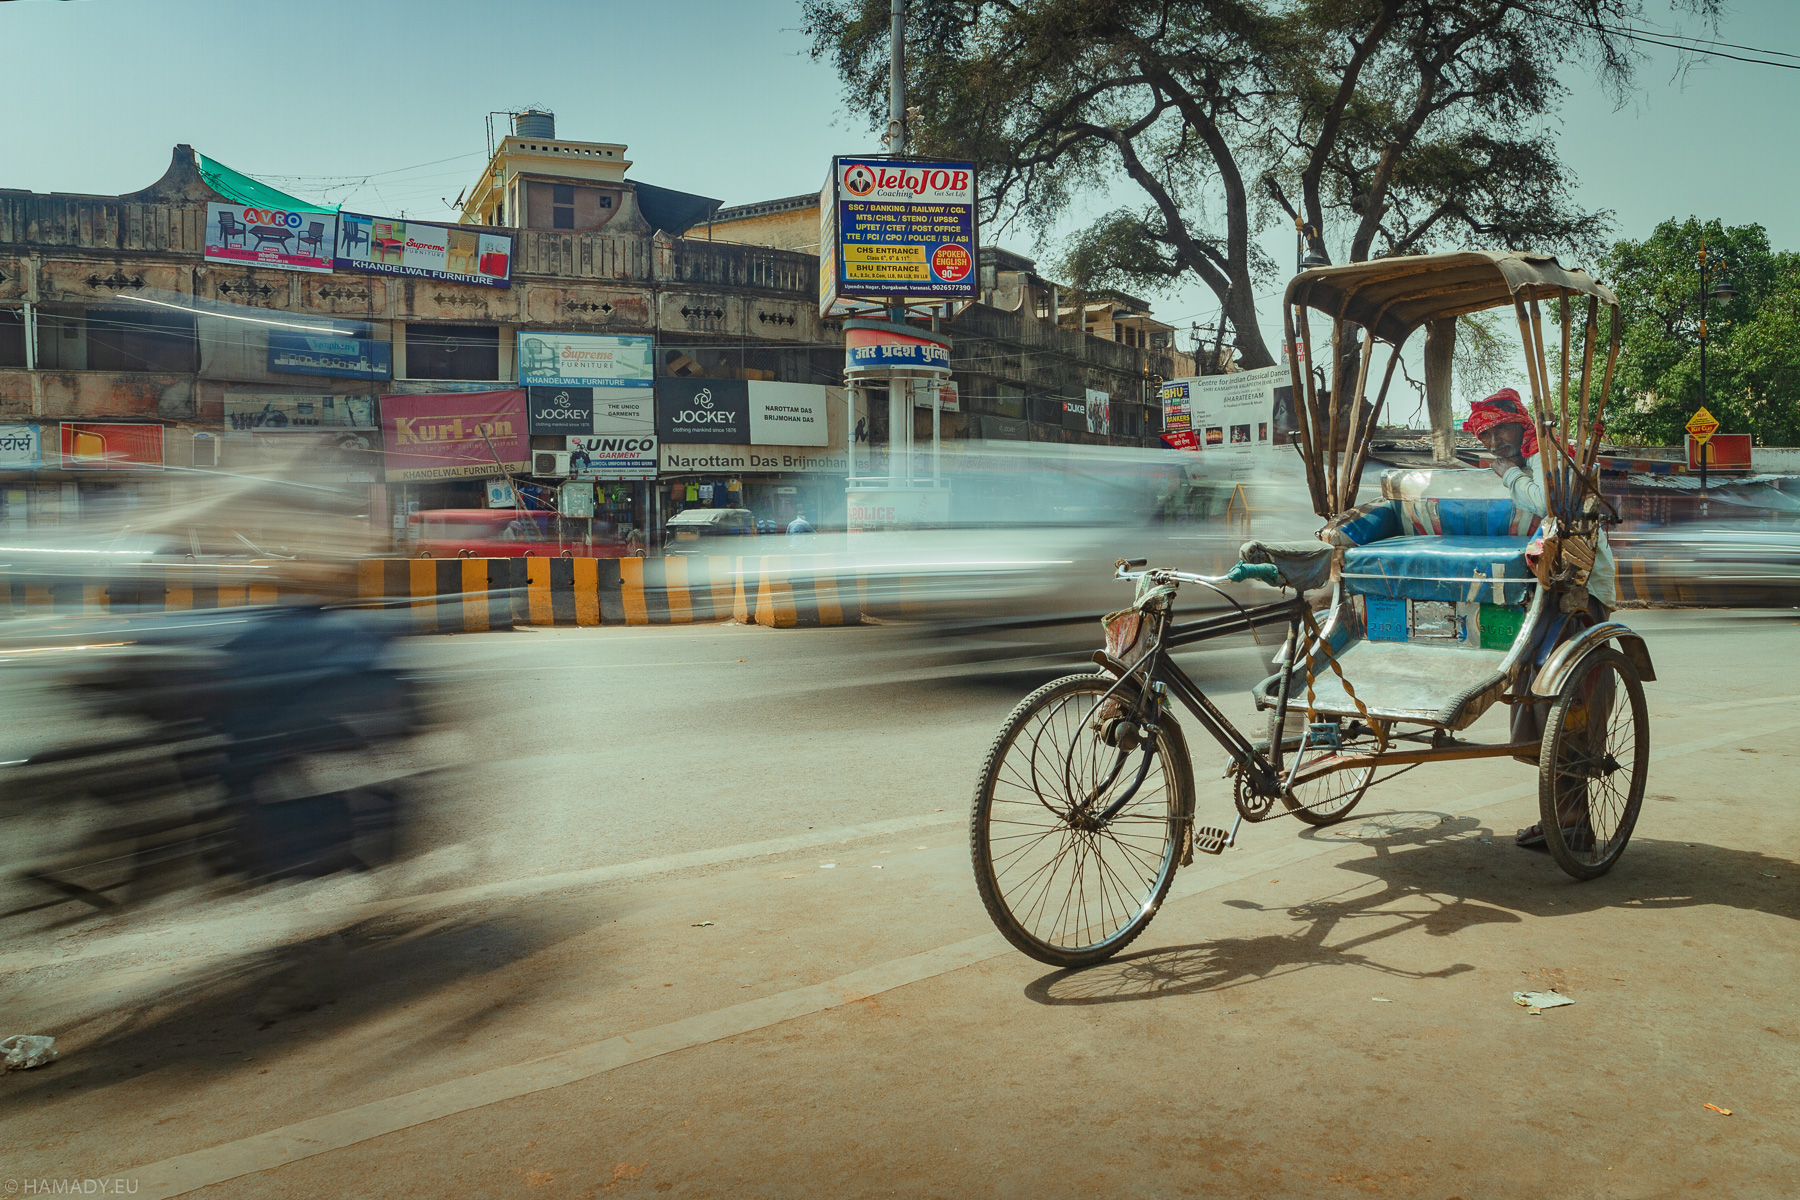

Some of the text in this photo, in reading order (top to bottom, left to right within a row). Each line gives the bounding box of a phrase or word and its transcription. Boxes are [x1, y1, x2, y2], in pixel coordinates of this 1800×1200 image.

[878, 168, 969, 194] leloJOB
[877, 189, 914, 199] Coaching
[246, 210, 300, 227] AVRO
[406, 238, 445, 251] Supreme
[406, 249, 445, 258] FURNITURE
[352, 260, 494, 285] KHANDELWAL FURNITURE
[942, 270, 952, 278] 90
[561, 346, 613, 361] Supreme
[855, 342, 948, 362] उत्तर प्रदेश पुलिस
[1247, 372, 1269, 382] Classical
[1270, 369, 1290, 378] Dances
[1164, 387, 1183, 399] BHU
[1223, 392, 1264, 403] BHARATEEYAM
[536, 409, 589, 419] JOCKEY
[672, 410, 735, 424] JOCKEY
[394, 418, 514, 445] Kurl-on
[587, 439, 654, 451] UNICO
[668, 455, 744, 467] Narottam
[750, 455, 778, 467] Das
[783, 456, 847, 470] Brijmohan
[403, 468, 461, 479] KHANDELWAL
[852, 507, 895, 520] POLICE
